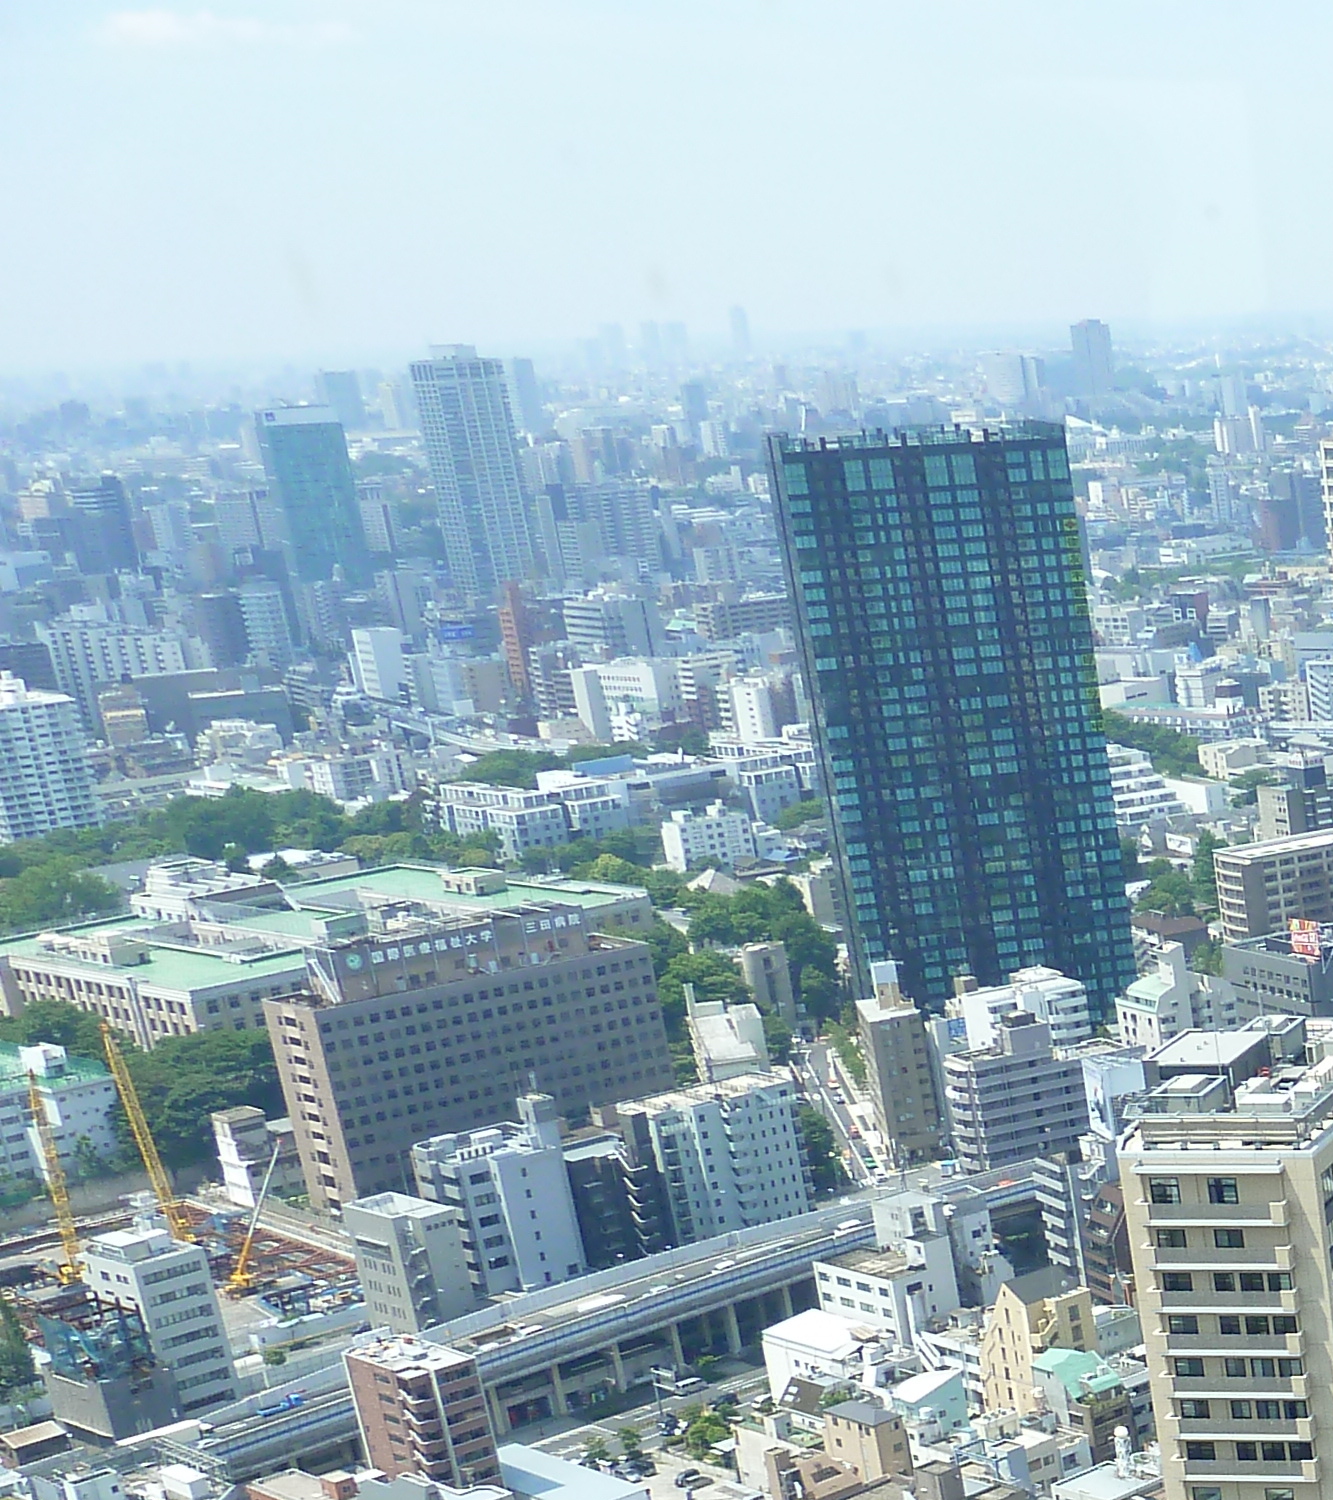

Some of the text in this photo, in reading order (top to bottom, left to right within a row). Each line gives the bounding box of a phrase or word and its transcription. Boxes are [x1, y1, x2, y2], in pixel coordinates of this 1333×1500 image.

[371, 913, 582, 965] 国際医療福祉大学 三田病院
